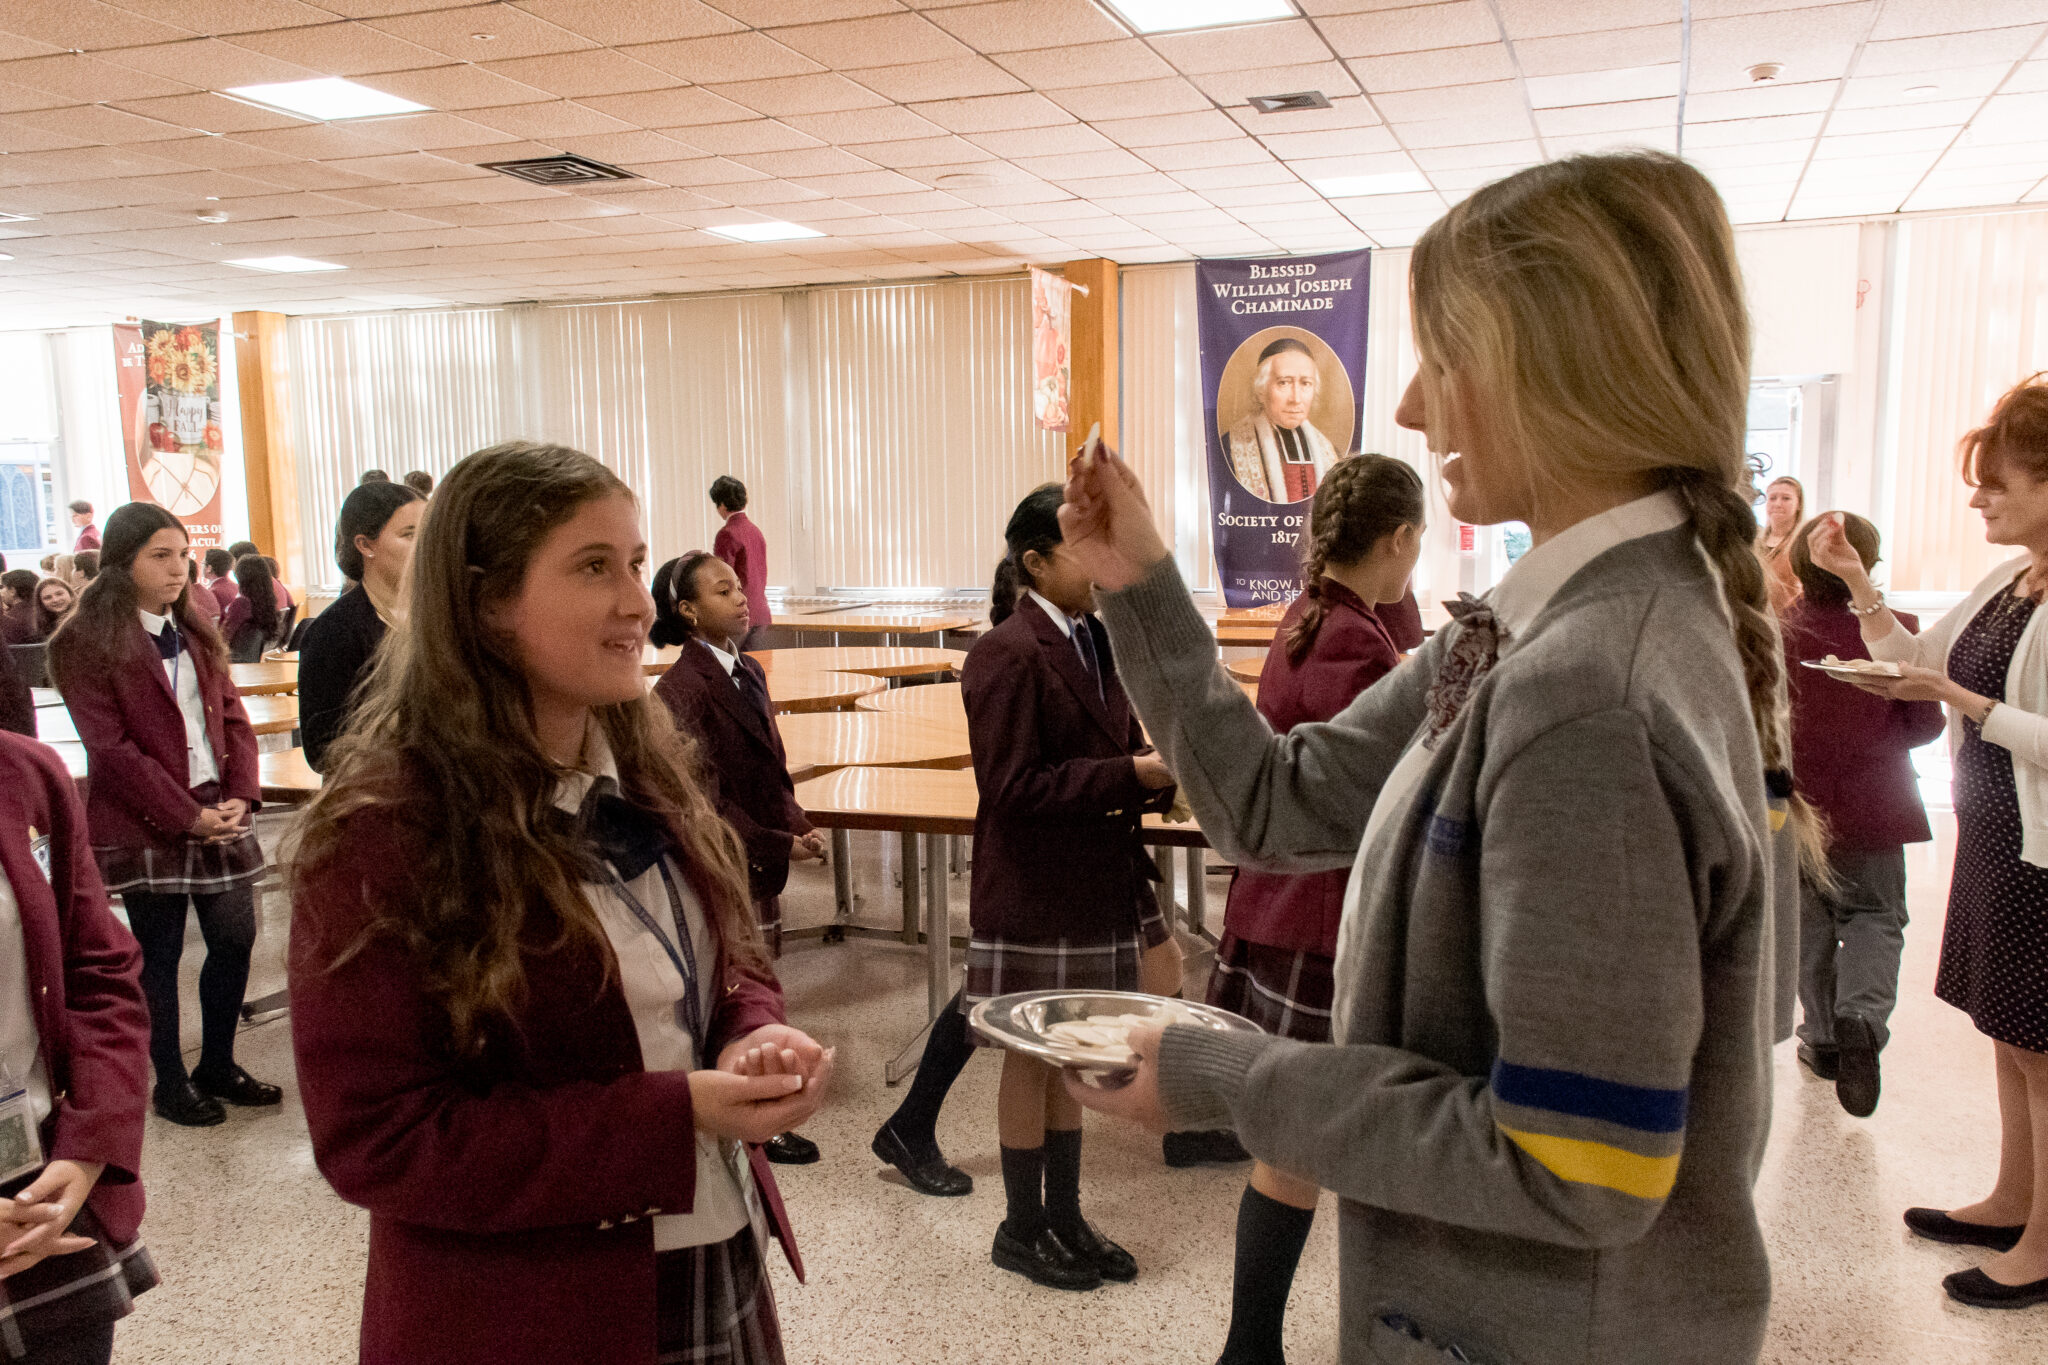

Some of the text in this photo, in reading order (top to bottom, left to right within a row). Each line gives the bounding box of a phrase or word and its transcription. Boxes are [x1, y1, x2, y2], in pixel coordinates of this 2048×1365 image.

[1249, 263, 1317, 280] BLESSED
[1213, 278, 1353, 299] WILLIAM JOSEPH
[1231, 297, 1334, 315] CHAMINADE
[1218, 512, 1304, 527] SOCIETY OF
[1271, 530, 1300, 548] 1817
[1235, 578, 1246, 586] TO
[1251, 590, 1281, 602] AND
